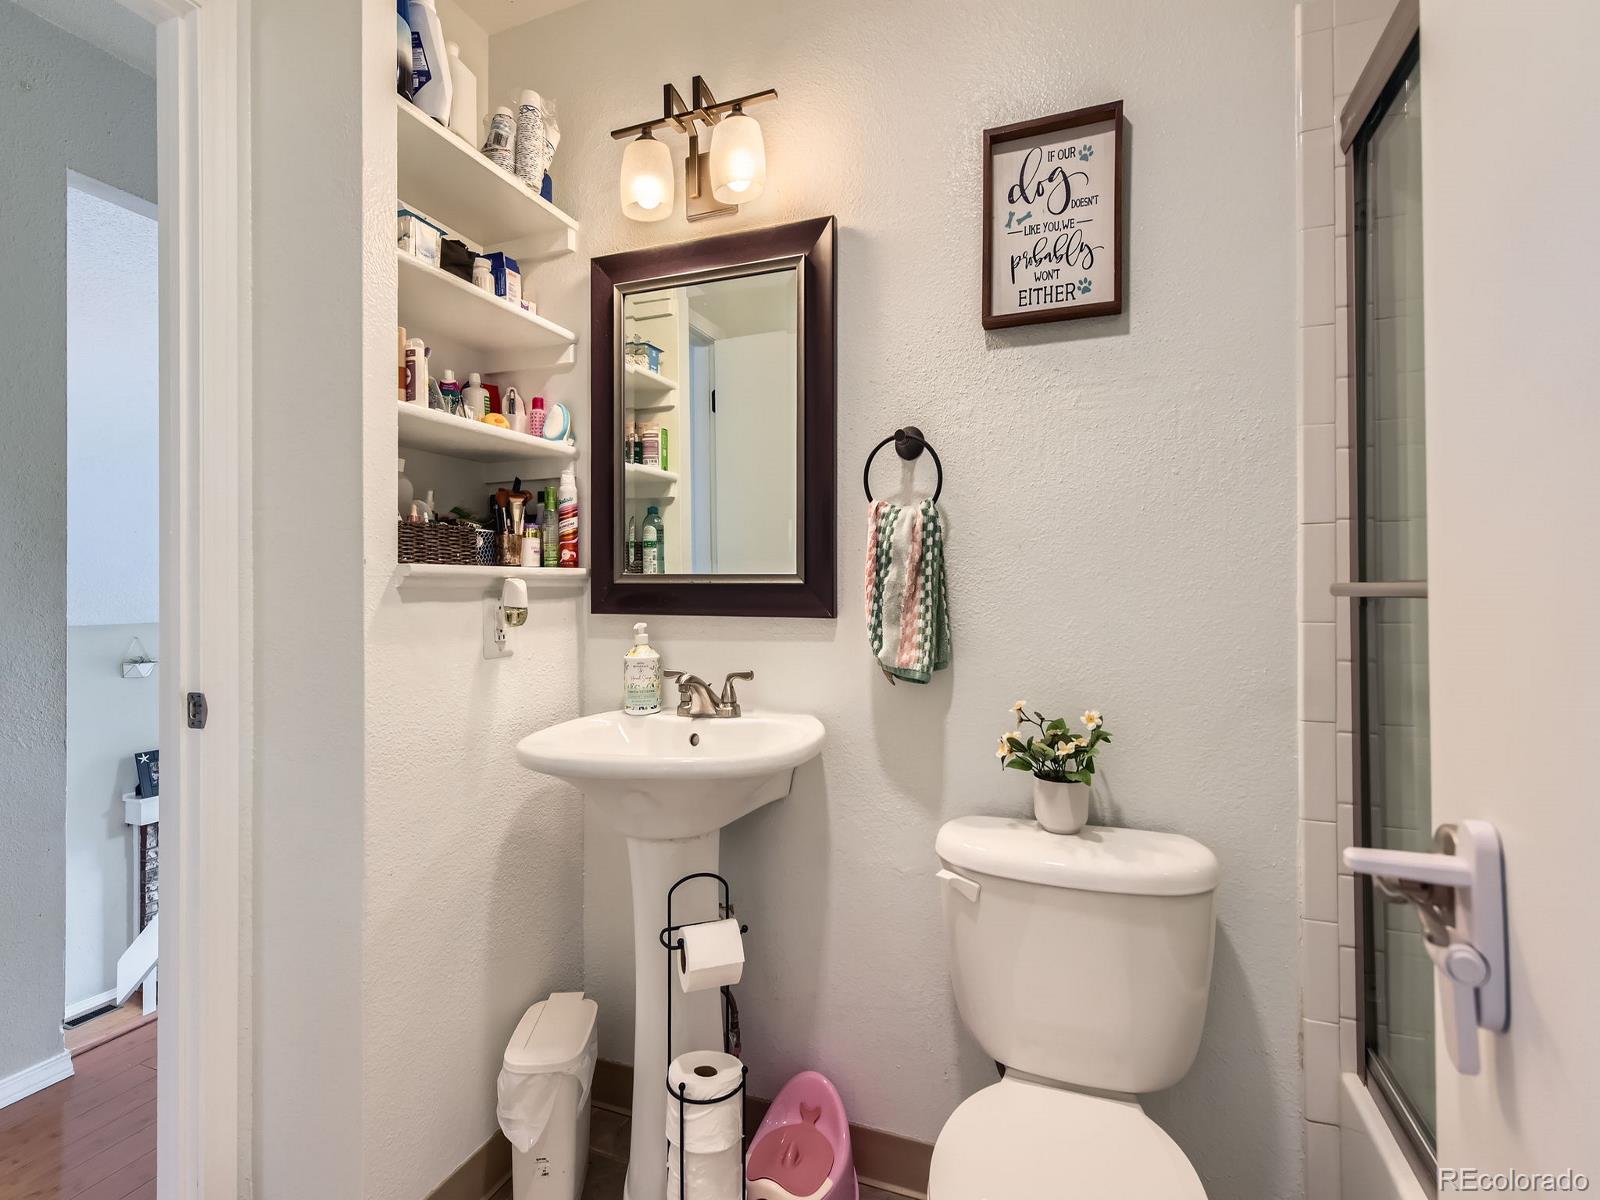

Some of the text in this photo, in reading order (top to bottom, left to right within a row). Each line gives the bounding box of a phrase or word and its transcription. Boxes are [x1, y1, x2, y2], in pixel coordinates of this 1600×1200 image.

[1047, 147, 1076, 162] IF OUR
[1007, 147, 1089, 215] dog
[1071, 195, 1099, 209] DOESN'T
[1024, 222, 1041, 236] LIKE
[1011, 229, 1104, 285] probably
[1033, 268, 1061, 282] WON'T
[1018, 283, 1076, 307] EITHER
